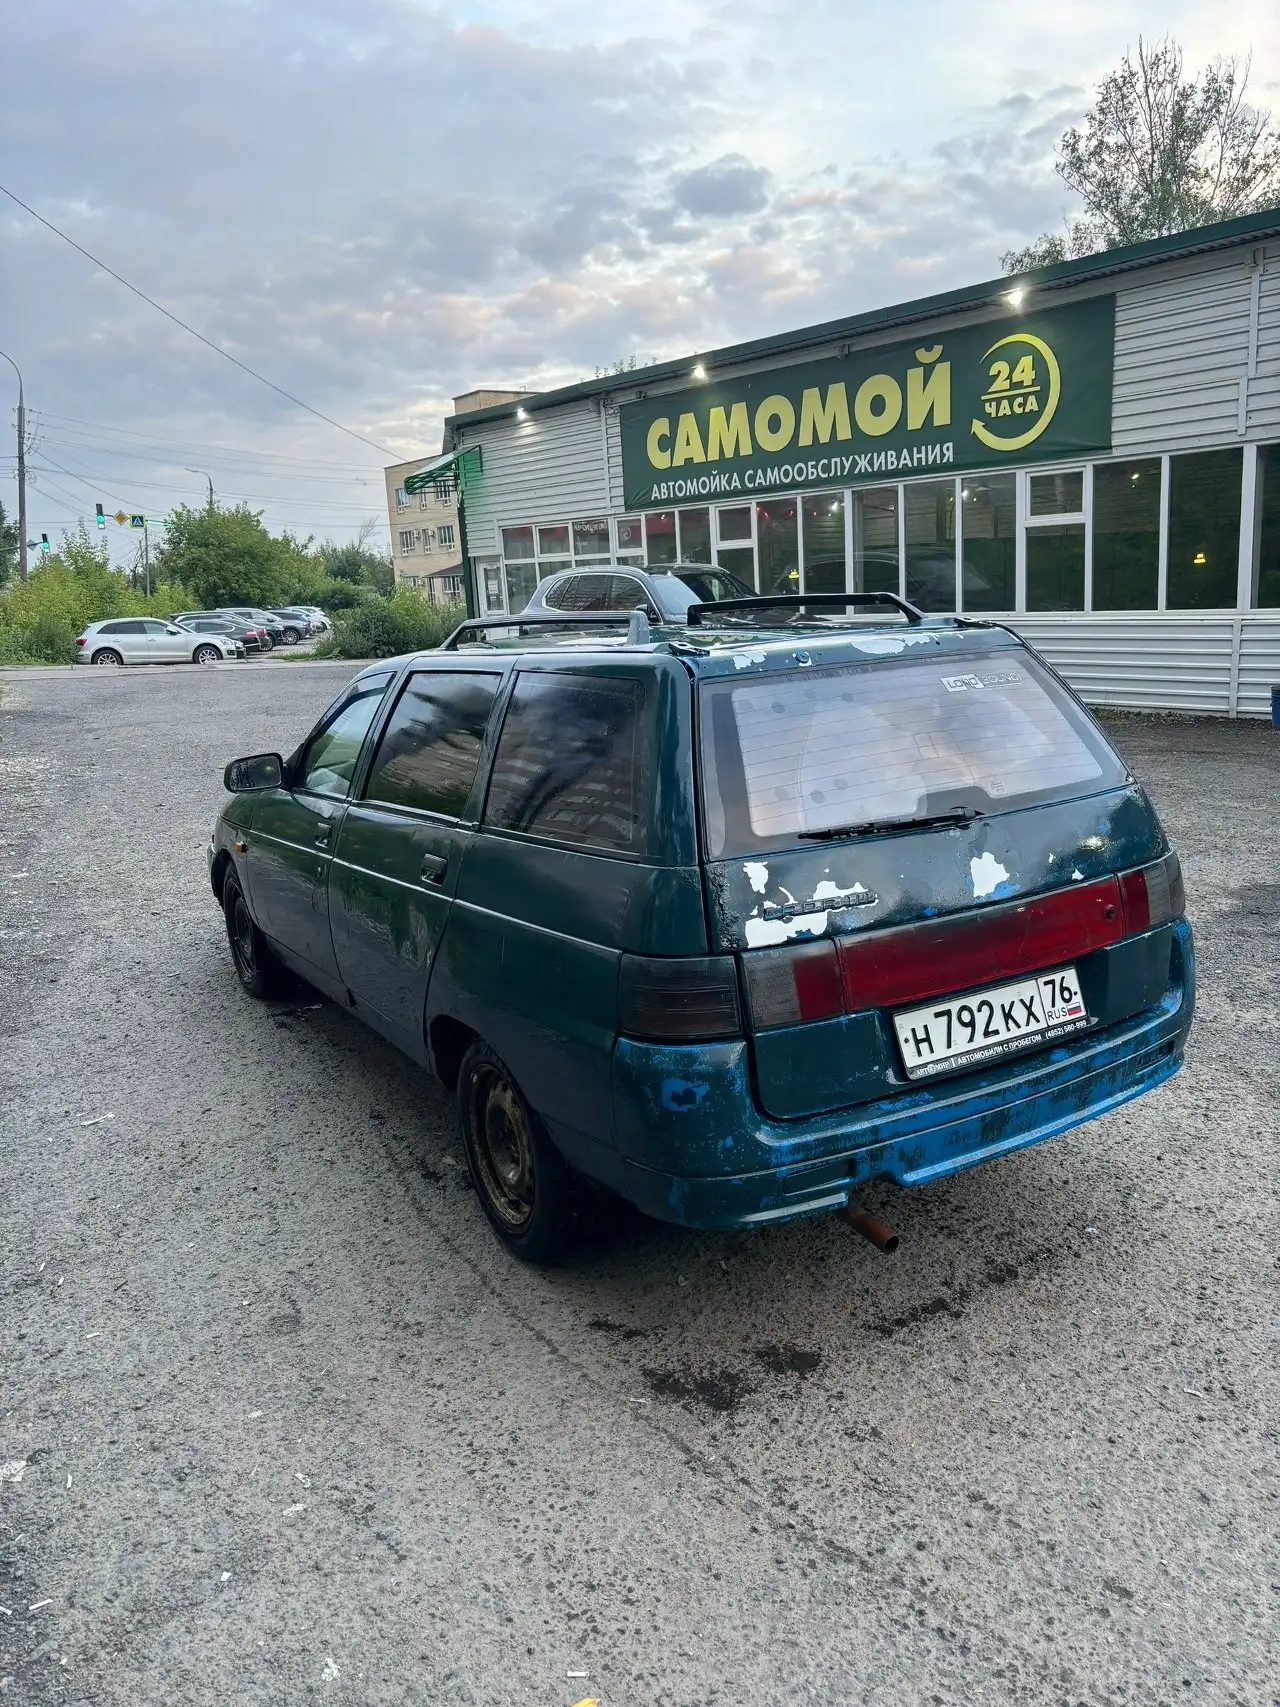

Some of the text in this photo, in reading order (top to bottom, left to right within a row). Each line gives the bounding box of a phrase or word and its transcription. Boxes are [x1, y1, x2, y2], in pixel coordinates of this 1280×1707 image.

[987, 354, 1036, 393] 24
[645, 344, 952, 470] САМОМОЙ
[984, 393, 1040, 419] ЧАСА
[650, 441, 954, 501] АВТОМОЙКА САМООБСЛУЖИВАНИЯ
[1043, 975, 1074, 1008] 76
[1047, 1006, 1068, 1021] RUS
[957, 1045, 1003, 1065] АВТОМОБИЛИ
[1009, 1033, 1042, 1049] ПРОБЕГОМ
